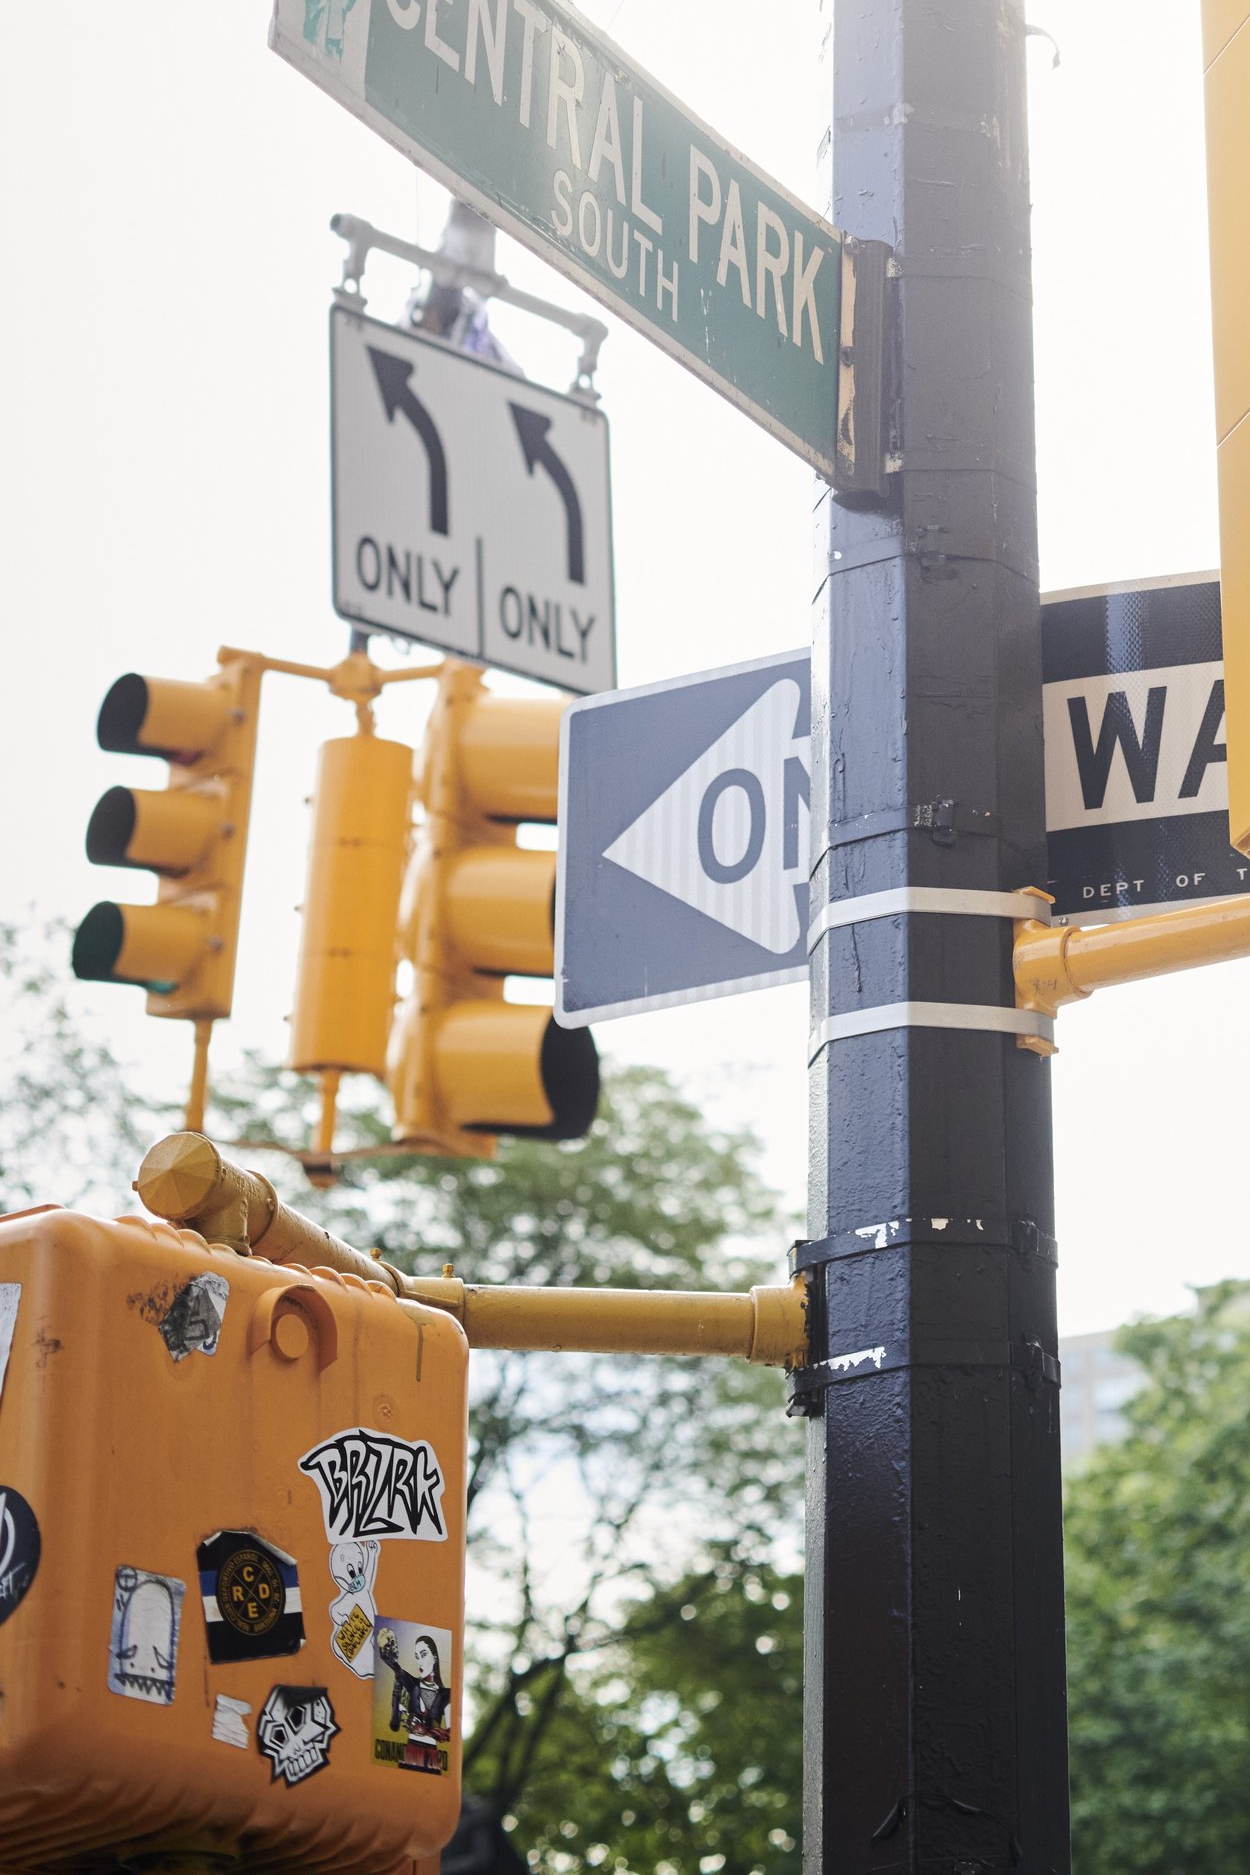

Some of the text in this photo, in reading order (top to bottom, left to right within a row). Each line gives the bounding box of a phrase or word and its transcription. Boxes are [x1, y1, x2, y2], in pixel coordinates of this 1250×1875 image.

[550, 170, 681, 322] SOUTH
[689, 145, 824, 365] PARK
[356, 536, 460, 617] ONLY
[499, 586, 596, 664] ONLY
[1083, 880, 1144, 898] DEPT
[1176, 873, 1206, 888] OF
[243, 1567, 254, 1582] C
